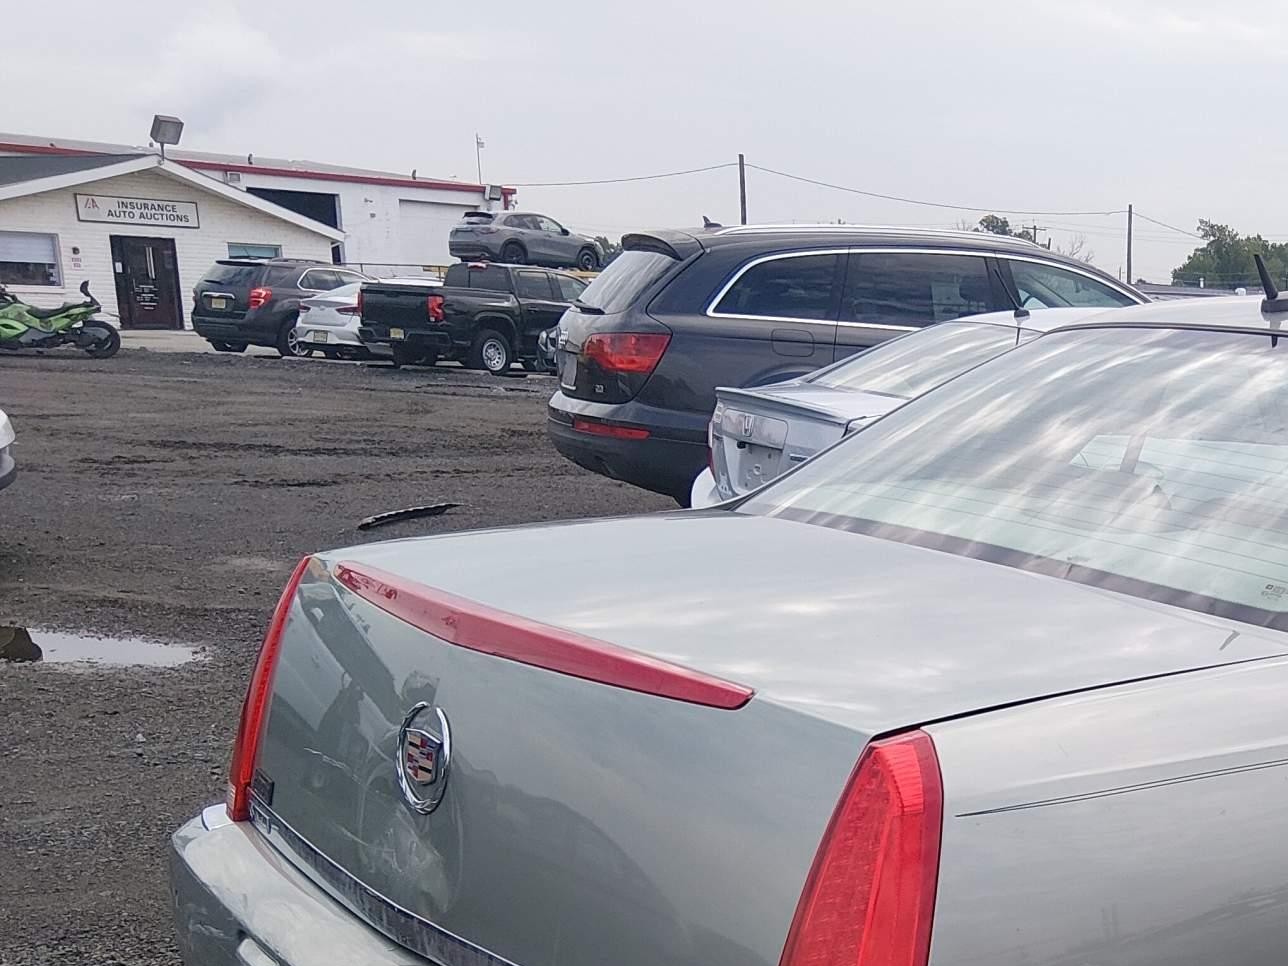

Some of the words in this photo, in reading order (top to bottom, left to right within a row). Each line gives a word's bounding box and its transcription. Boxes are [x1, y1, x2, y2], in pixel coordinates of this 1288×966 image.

[117, 200, 178, 213] INSURANCE
[107, 209, 136, 220] AUTO
[138, 211, 190, 223] AUCTIONS
